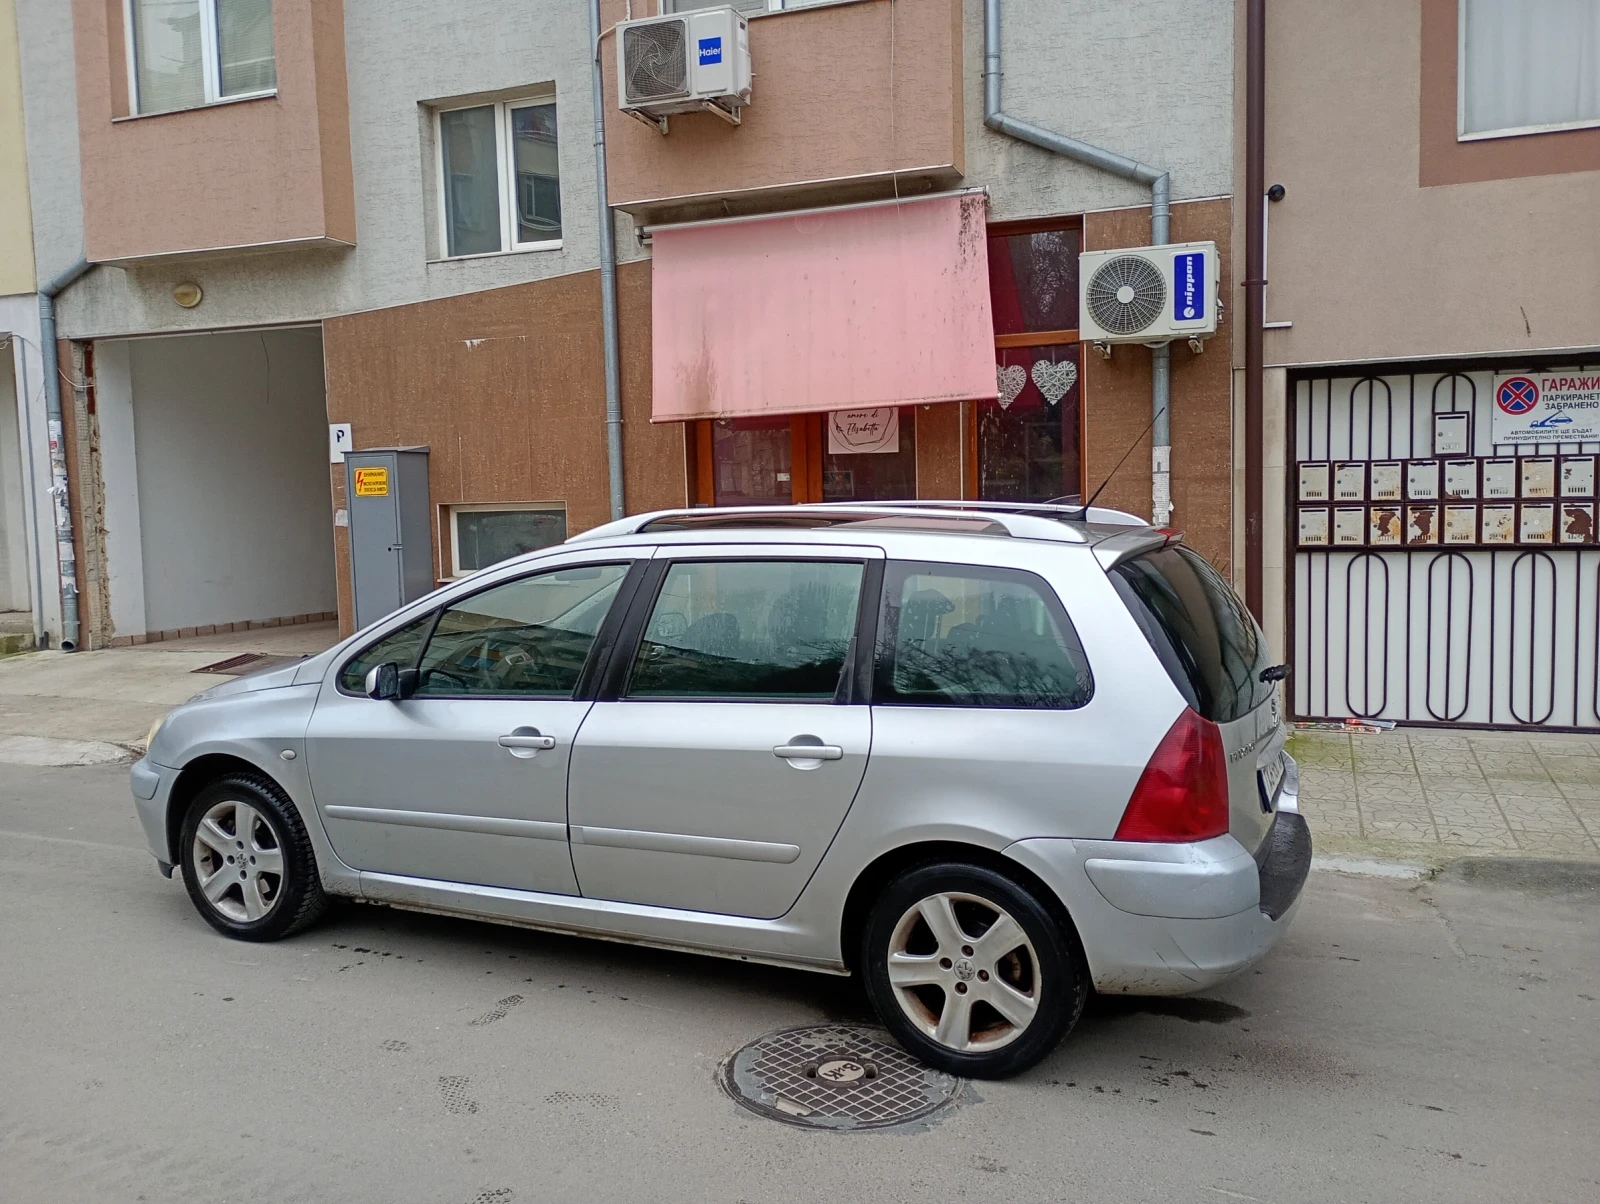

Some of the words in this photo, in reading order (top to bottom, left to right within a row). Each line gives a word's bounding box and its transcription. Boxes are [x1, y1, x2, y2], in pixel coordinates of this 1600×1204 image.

[699, 47, 721, 57] Haier
[1184, 256, 1195, 305] nippon
[1542, 376, 1600, 391] ГАРАЖИ
[1545, 401, 1599, 410] ЗАБРАНЕНО
[847, 422, 881, 436] Elisabetta
